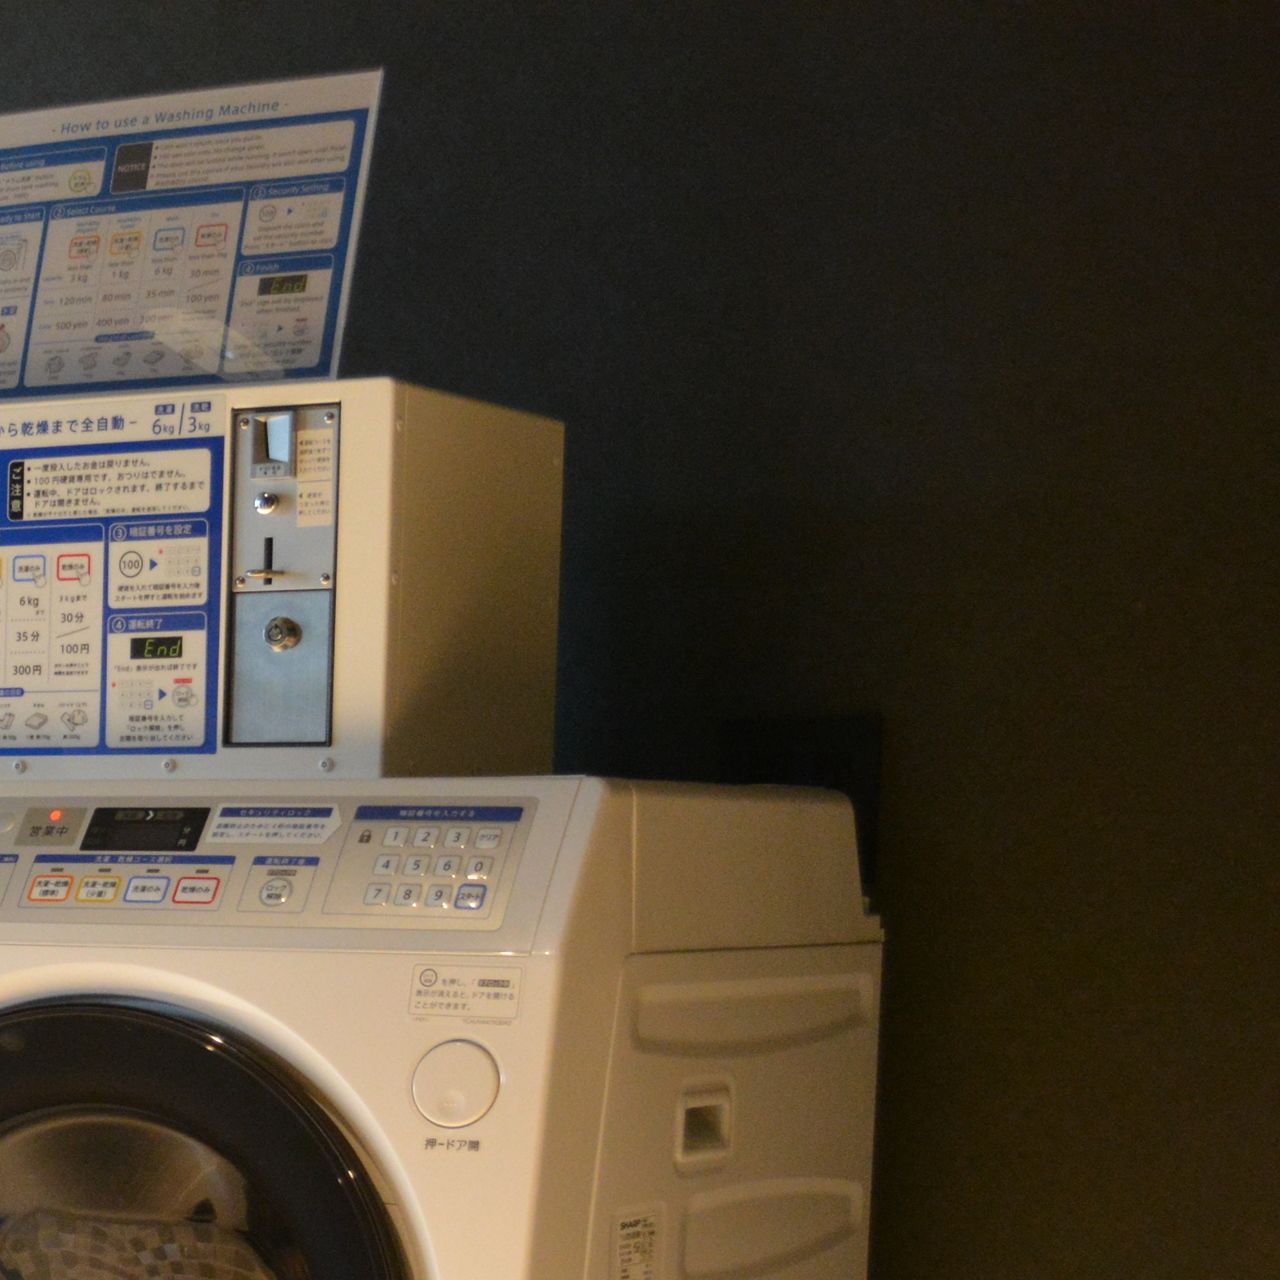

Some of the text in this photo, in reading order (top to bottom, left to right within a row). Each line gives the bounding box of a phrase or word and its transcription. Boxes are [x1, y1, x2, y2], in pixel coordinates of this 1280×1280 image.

[60, 99, 279, 136] How to use a Washing Machine
[268, 184, 300, 196] Security
[270, 276, 307, 294] End
[129, 524, 192, 538] 暗証番号を設定
[121, 559, 140, 570] 100
[143, 638, 183, 658] End
[29, 825, 69, 838] 営業中
[620, 1219, 641, 1231] SHARP
